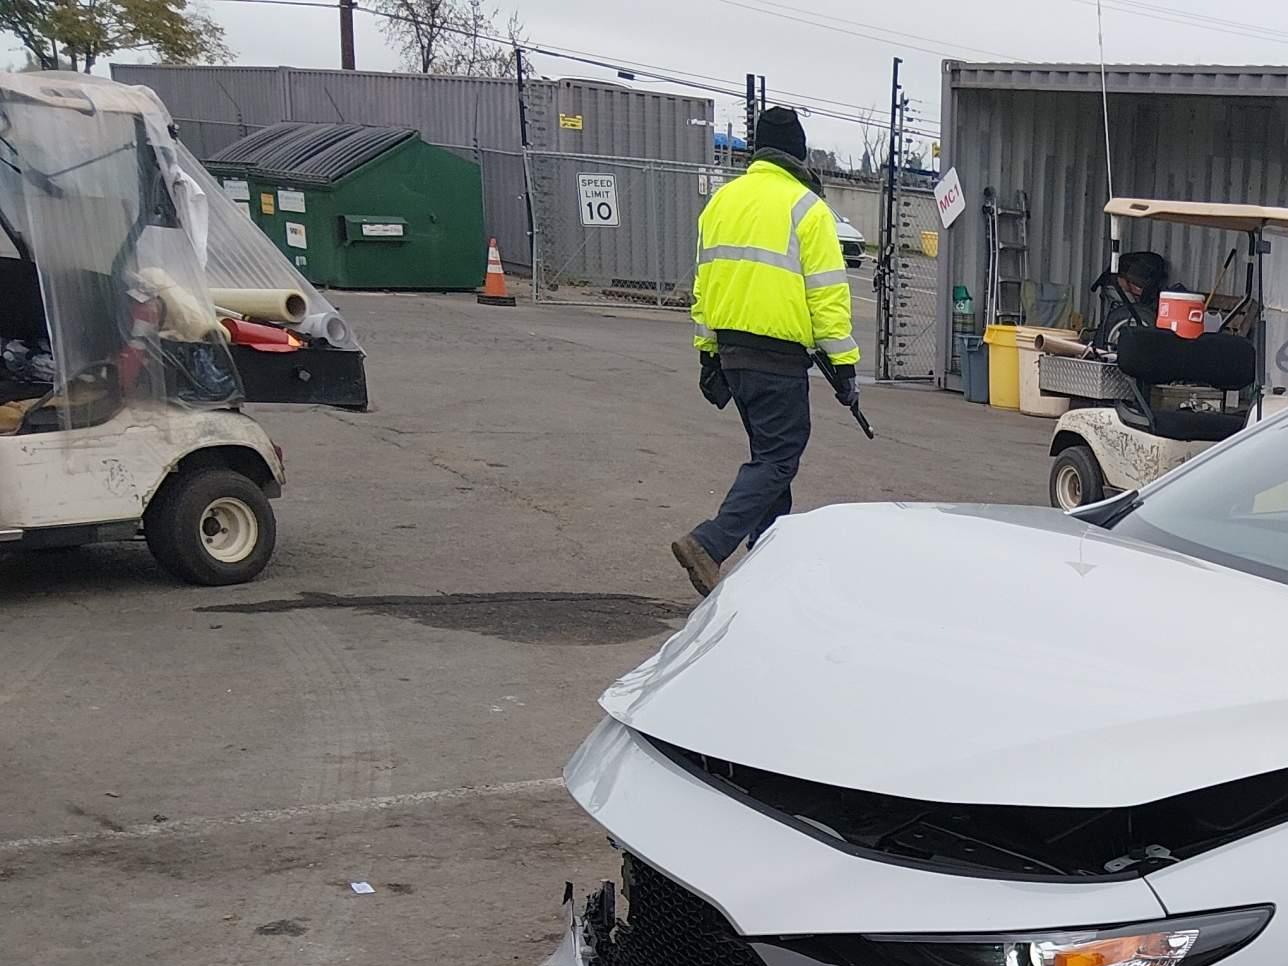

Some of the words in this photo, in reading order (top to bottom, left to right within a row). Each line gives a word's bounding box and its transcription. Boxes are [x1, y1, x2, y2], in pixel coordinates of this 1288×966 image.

[581, 179, 613, 188] SPEED
[585, 190, 610, 199] LIMIT
[586, 201, 612, 220] 10
